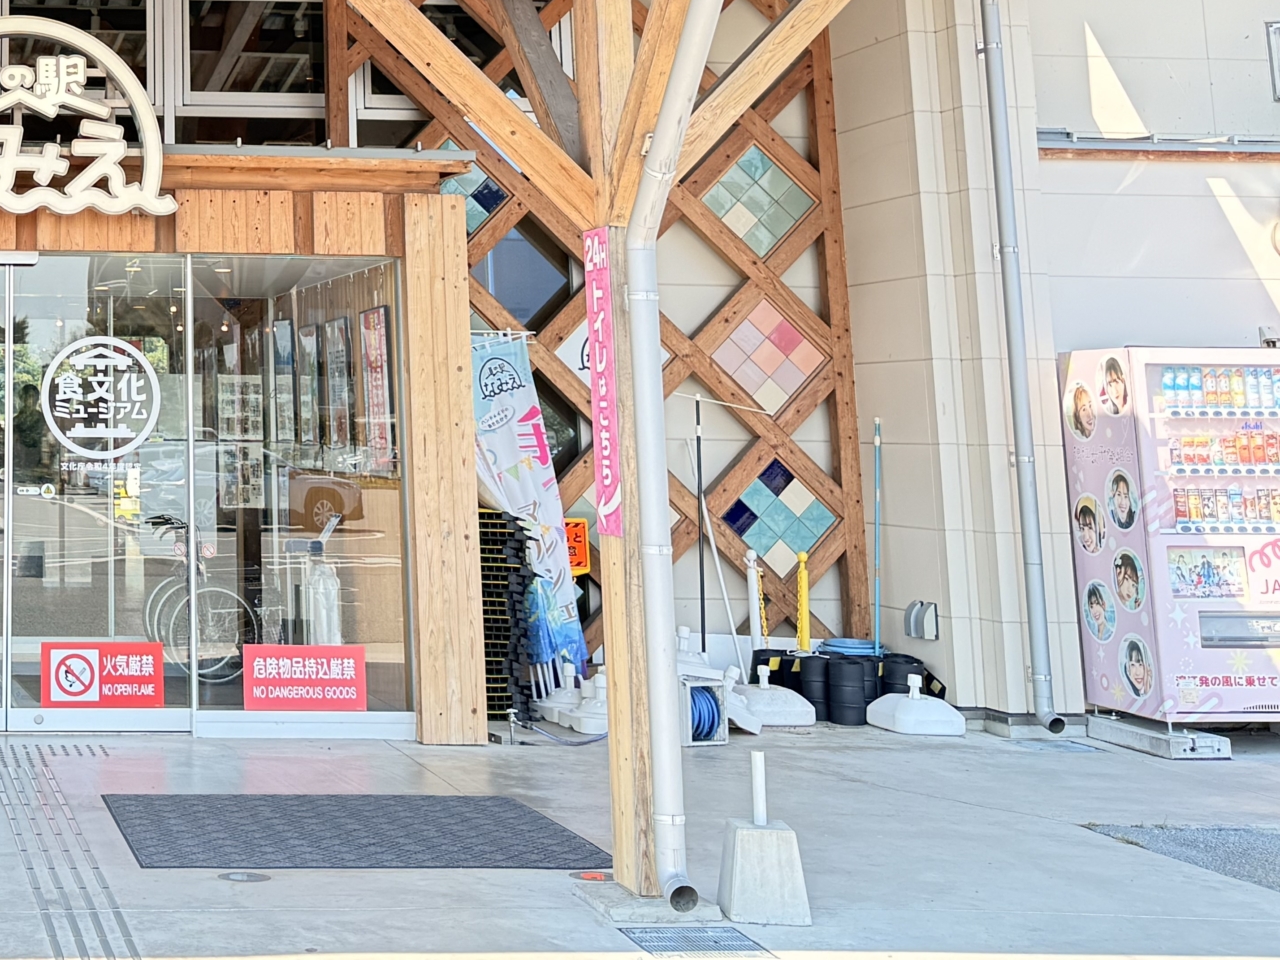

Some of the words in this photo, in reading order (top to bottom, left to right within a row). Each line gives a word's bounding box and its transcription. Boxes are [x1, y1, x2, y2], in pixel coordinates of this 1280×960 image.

[585, 235, 607, 271] 24H
[54, 372, 147, 401] 食文化
[592, 280, 612, 486] トイレはこちら
[53, 401, 148, 419] ミュージアム
[102, 654, 155, 676] 火気厳禁
[253, 657, 356, 679] 危険物品持込厳禁
[102, 684, 113, 696] NO
[114, 684, 132, 696] OPEN
[133, 684, 155, 696] FLAME
[253, 686, 266, 698] NO
[268, 686, 323, 699] DANGEROUS
[325, 686, 357, 699] GOODS
